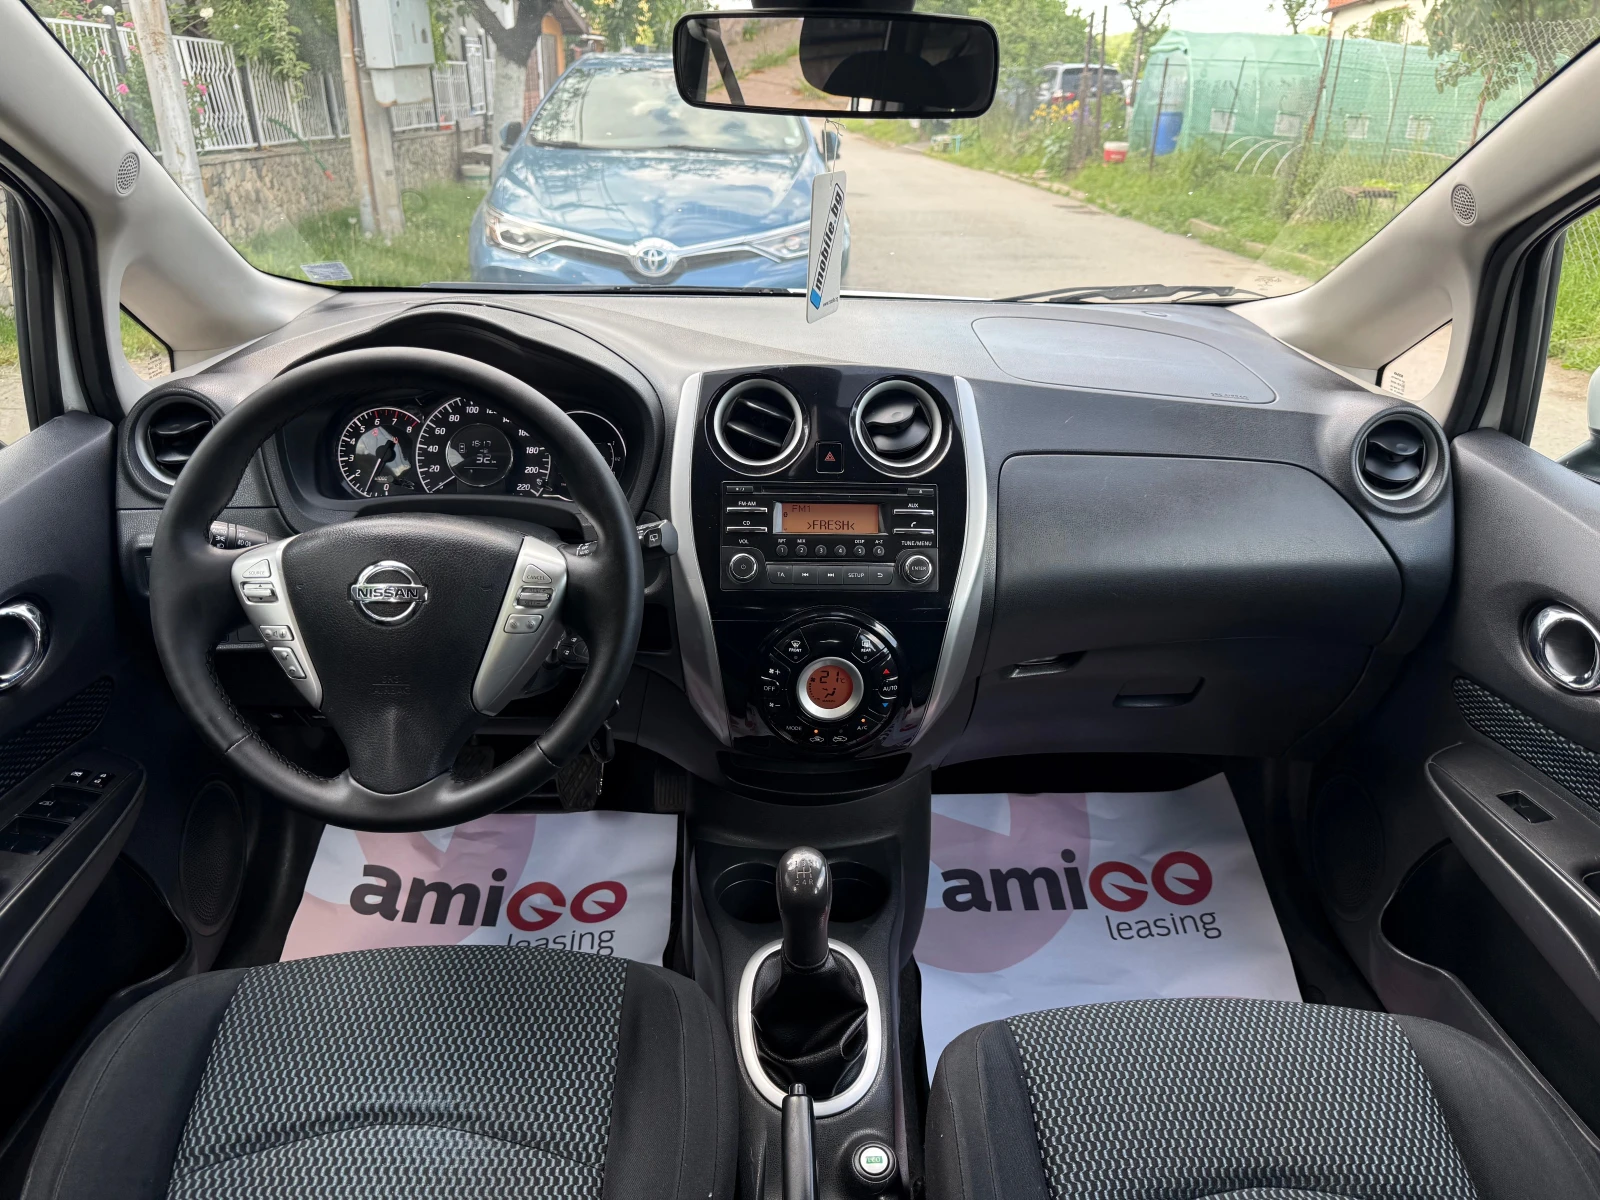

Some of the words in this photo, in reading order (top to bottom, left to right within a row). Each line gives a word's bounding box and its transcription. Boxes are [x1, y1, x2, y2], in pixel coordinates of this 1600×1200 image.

[815, 189, 844, 292] mobile.bg
[465, 406, 479, 414] 100
[448, 414, 460, 422] 80
[359, 425, 366, 433] 5
[434, 427, 446, 435] 60
[427, 445, 439, 453] 40
[525, 446, 539, 454] 180
[348, 454, 354, 462] 3
[476, 453, 492, 464] 32
[429, 464, 440, 472] 20
[524, 466, 539, 474] 200
[355, 469, 361, 477] 2
[383, 483, 390, 491] 0
[516, 483, 531, 491] 220
[792, 504, 811, 513] FM1
[357, 588, 419, 599] NISSAN
[820, 670, 840, 684] 21
[1105, 911, 1222, 940] leasing
